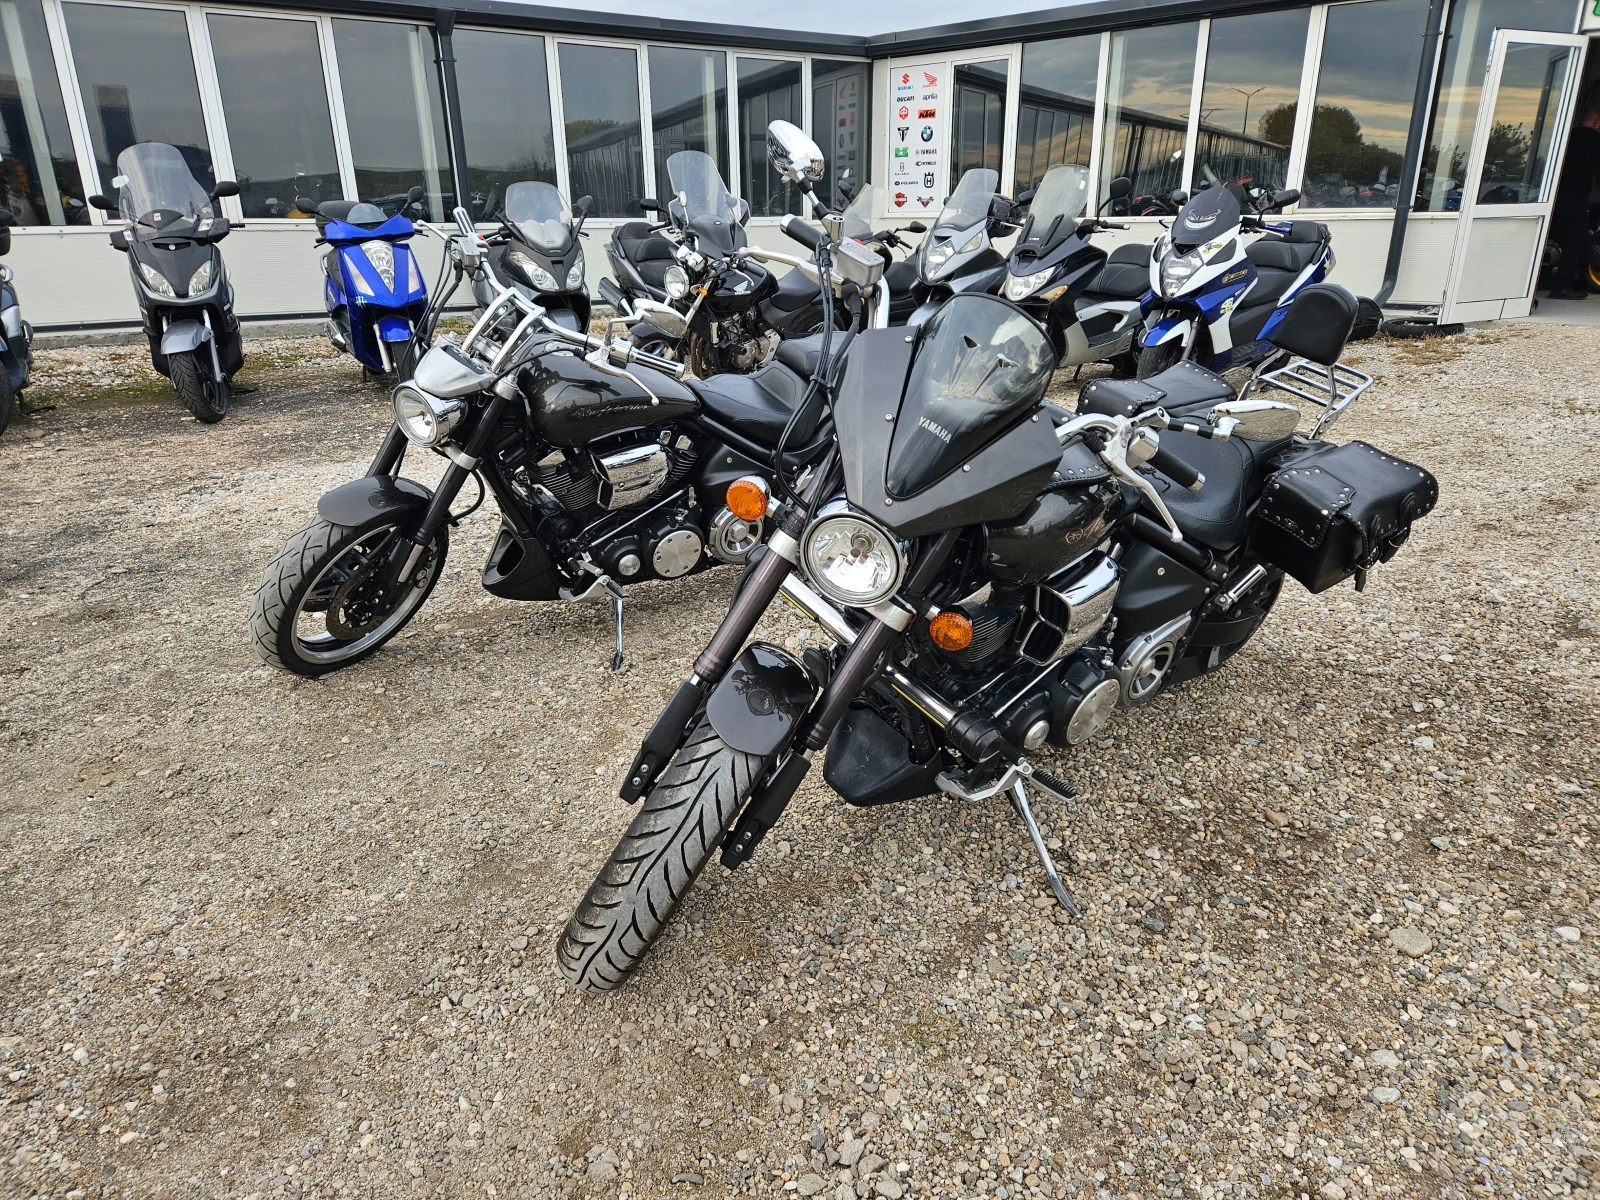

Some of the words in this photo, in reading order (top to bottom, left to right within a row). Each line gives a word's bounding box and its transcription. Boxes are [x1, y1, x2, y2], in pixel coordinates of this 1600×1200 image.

[922, 93, 937, 101] aprilia
[919, 110, 935, 119] KTM
[918, 416, 952, 444] YAMAHA
